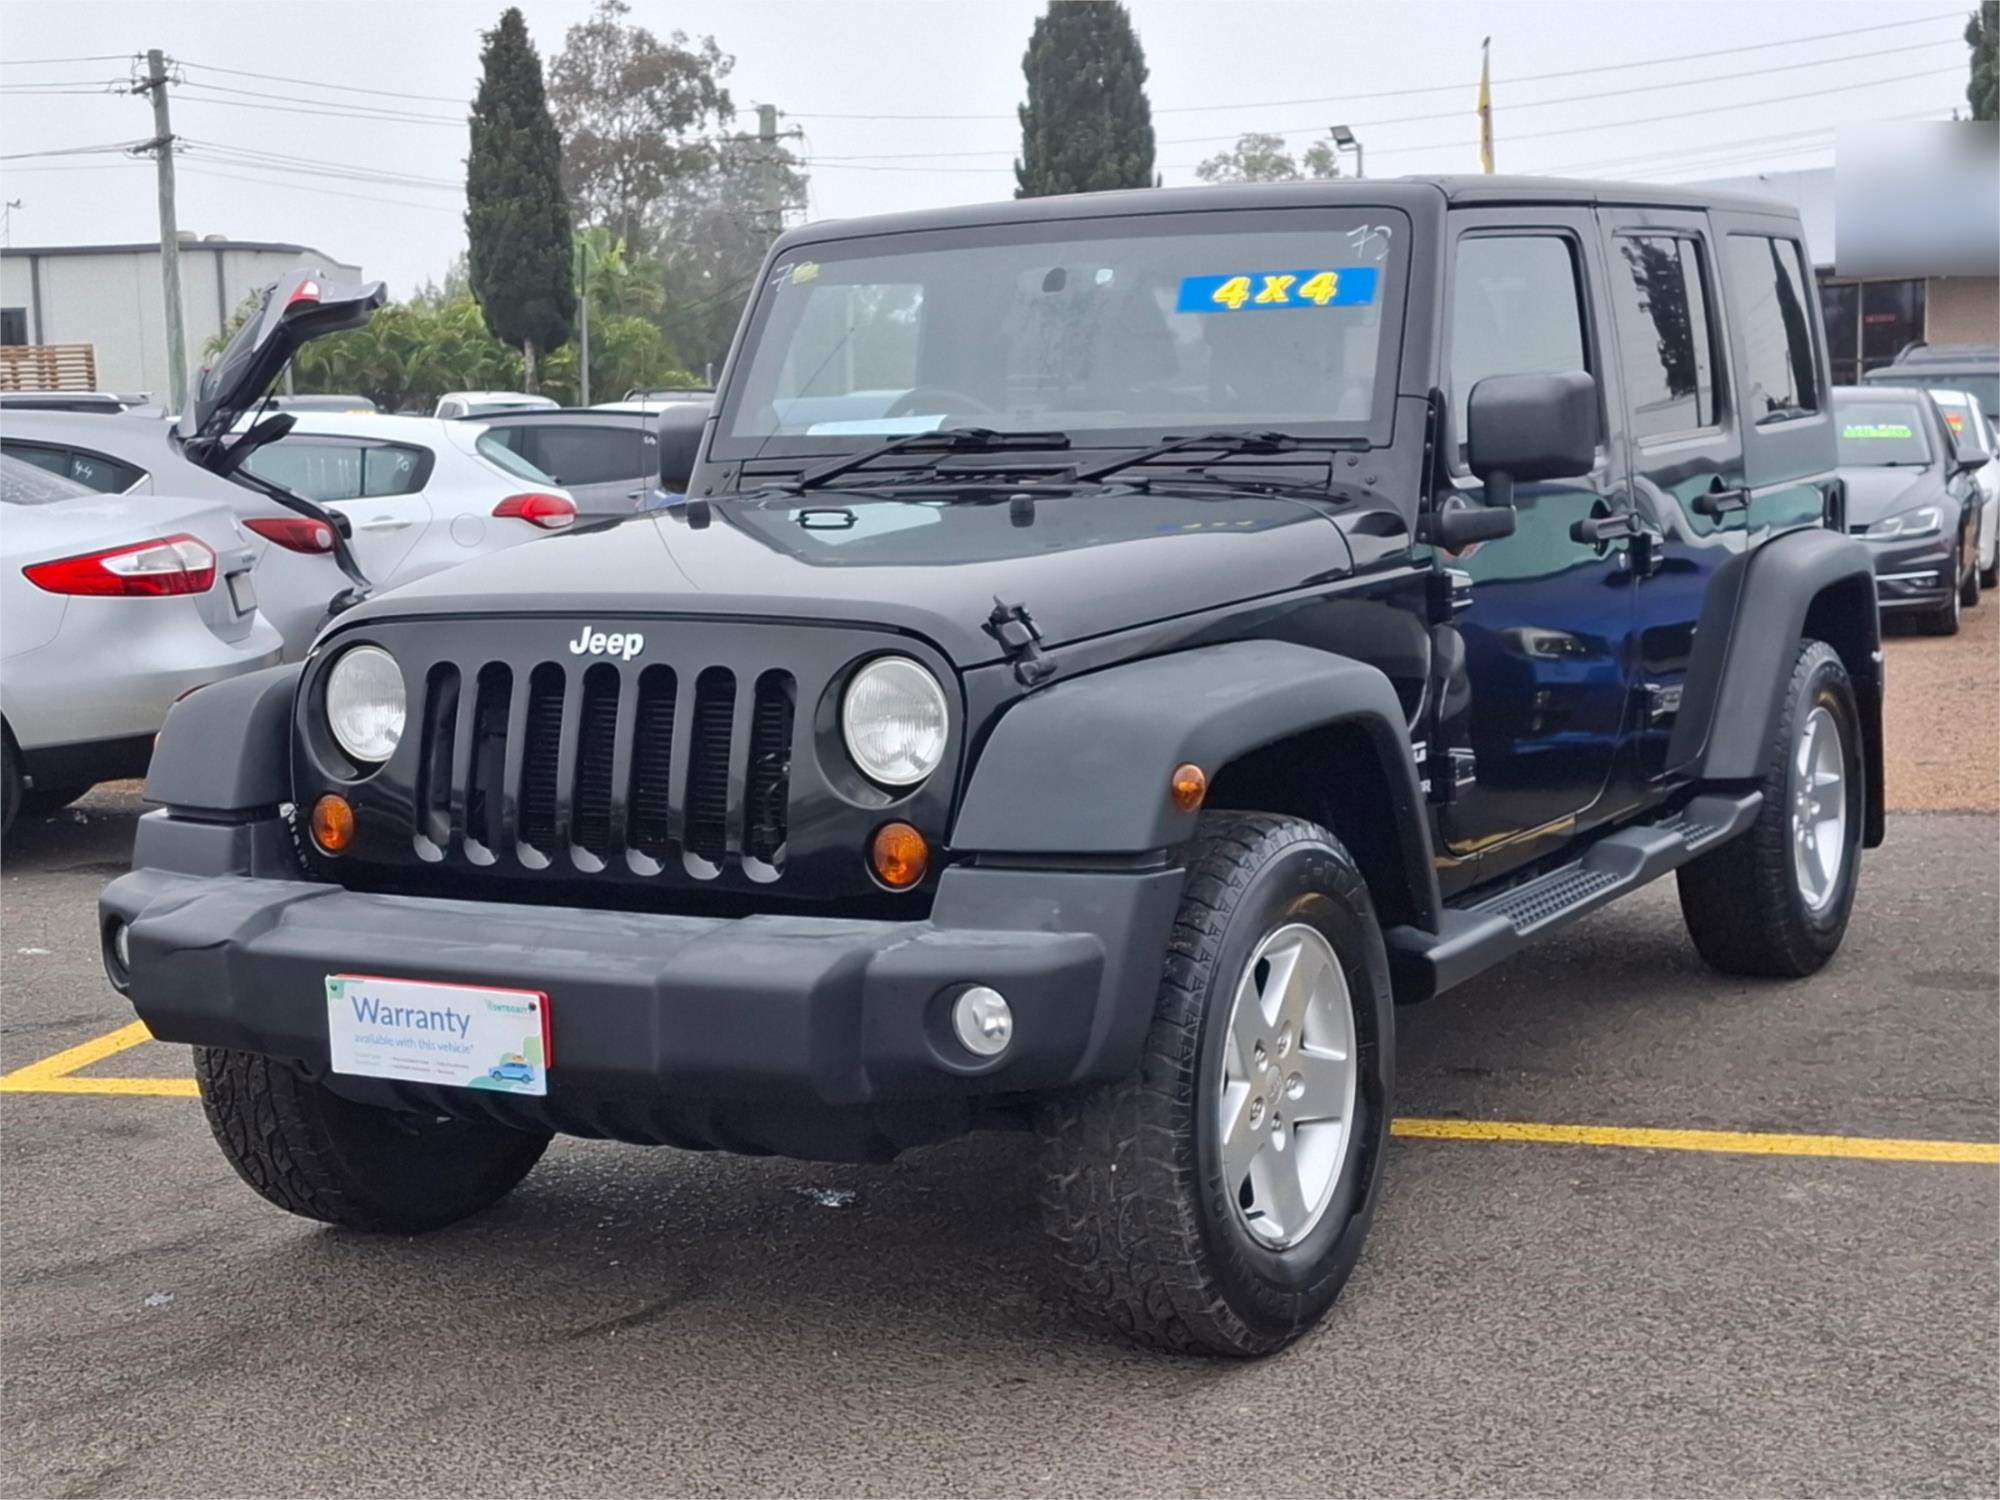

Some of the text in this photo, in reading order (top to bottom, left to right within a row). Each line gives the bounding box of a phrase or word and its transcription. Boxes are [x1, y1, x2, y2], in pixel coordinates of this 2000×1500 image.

[569, 625, 645, 662] Jeep
[351, 995, 471, 1040] Warranty
[353, 1033, 394, 1047] available
[396, 1037, 418, 1049] with
[418, 1039, 436, 1050] this
